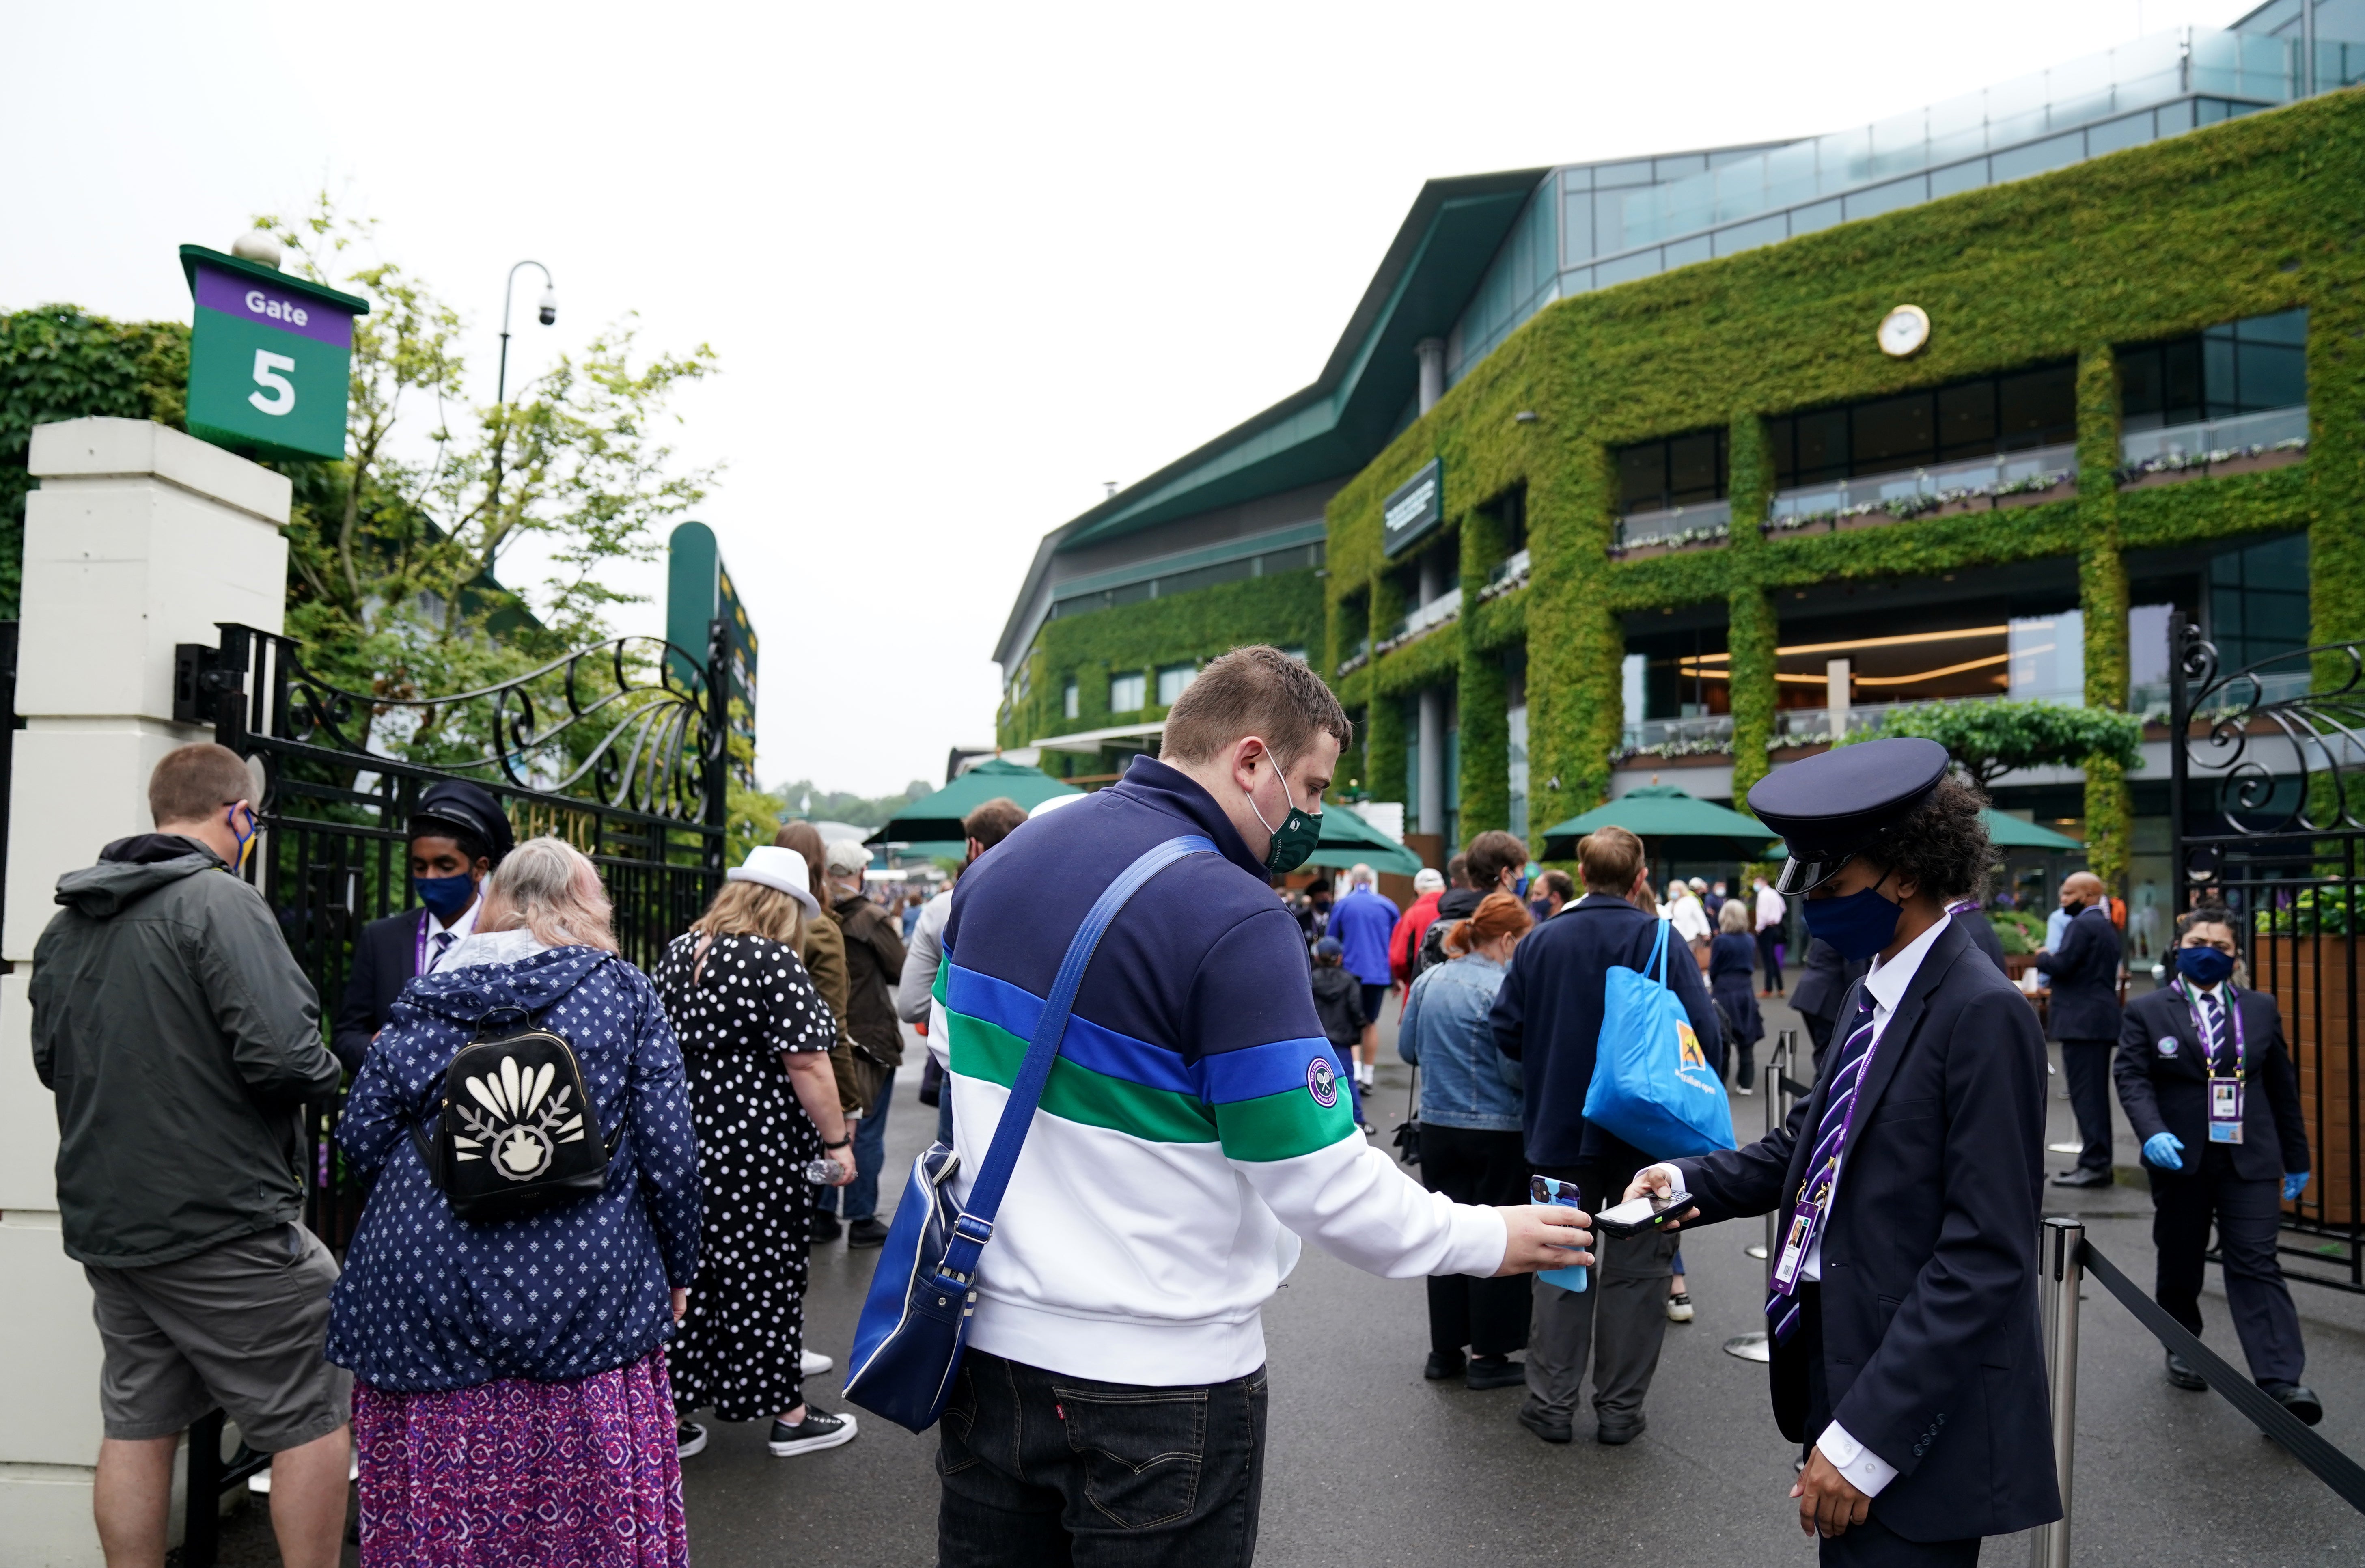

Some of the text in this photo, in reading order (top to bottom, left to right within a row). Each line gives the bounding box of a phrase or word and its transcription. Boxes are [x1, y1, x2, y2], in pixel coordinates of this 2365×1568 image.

[245, 290, 309, 327] Gate
[248, 348, 296, 416] 5
[1273, 839, 1282, 864] LEICESTER
[1312, 1061, 1334, 1079] CHAMPIONSHIPS
[1317, 1091, 1335, 1103] WIMBLEDON
[1701, 1082, 1716, 1095] open
